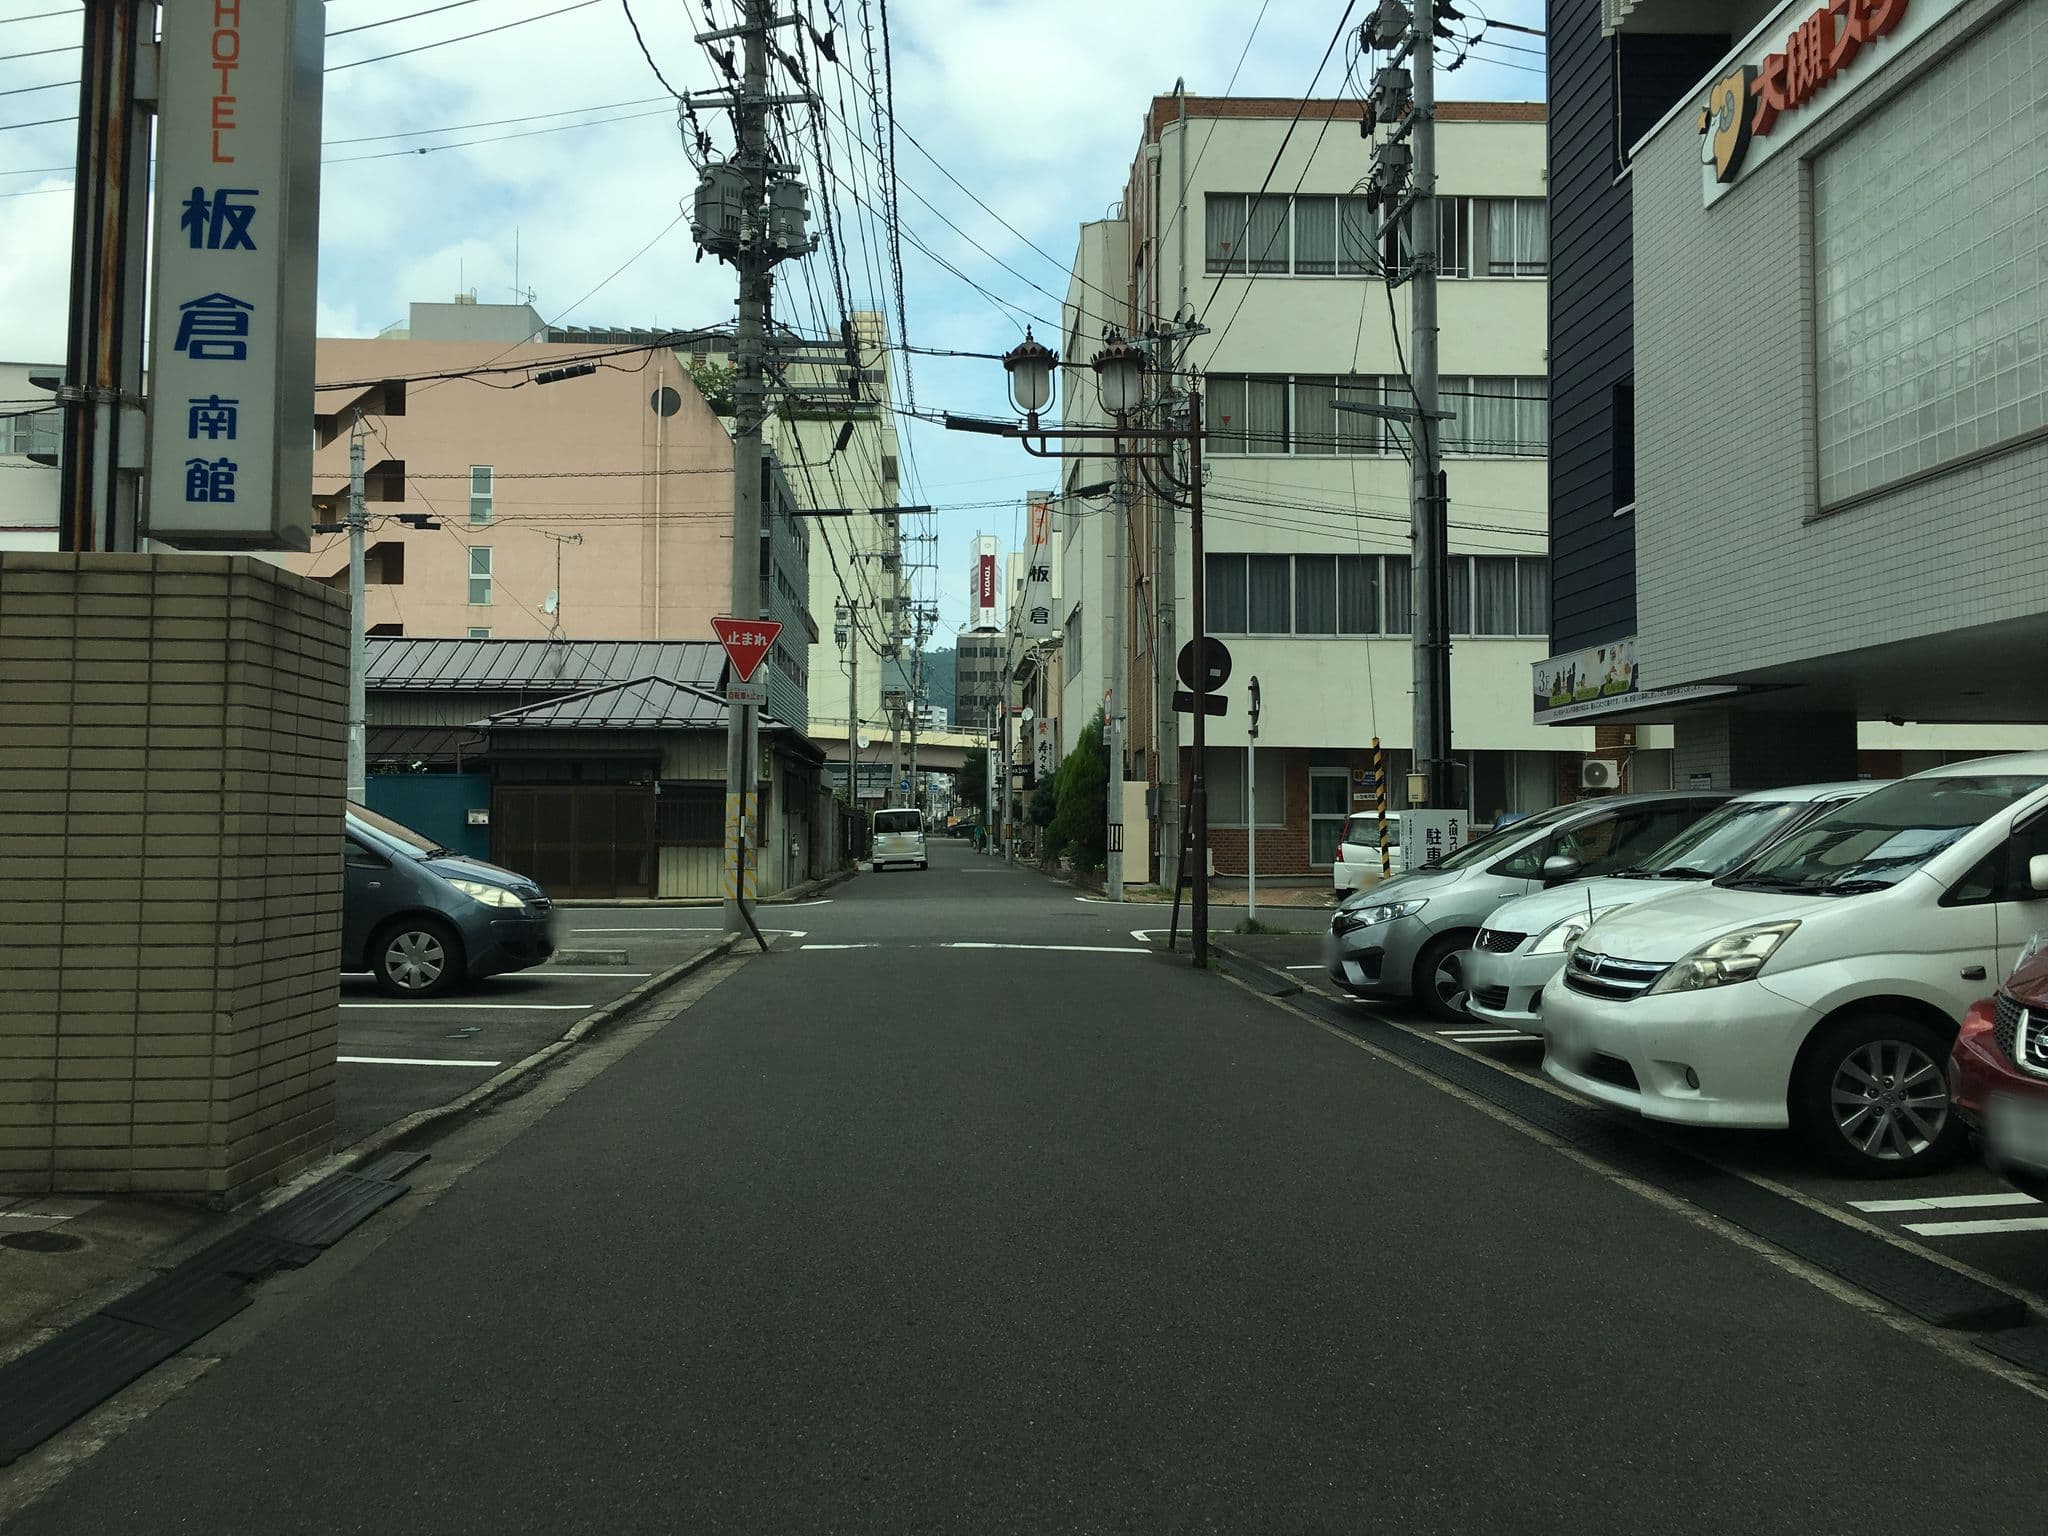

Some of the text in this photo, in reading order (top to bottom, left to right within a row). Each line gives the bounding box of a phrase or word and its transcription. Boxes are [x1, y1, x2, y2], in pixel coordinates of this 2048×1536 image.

[211, 0, 240, 163] HOTEL
[174, 186, 259, 503] 板倉南館
[1029, 566, 1050, 625] 板倉
[726, 631, 768, 646] 止まれ
[1538, 670, 1551, 693] 3F
